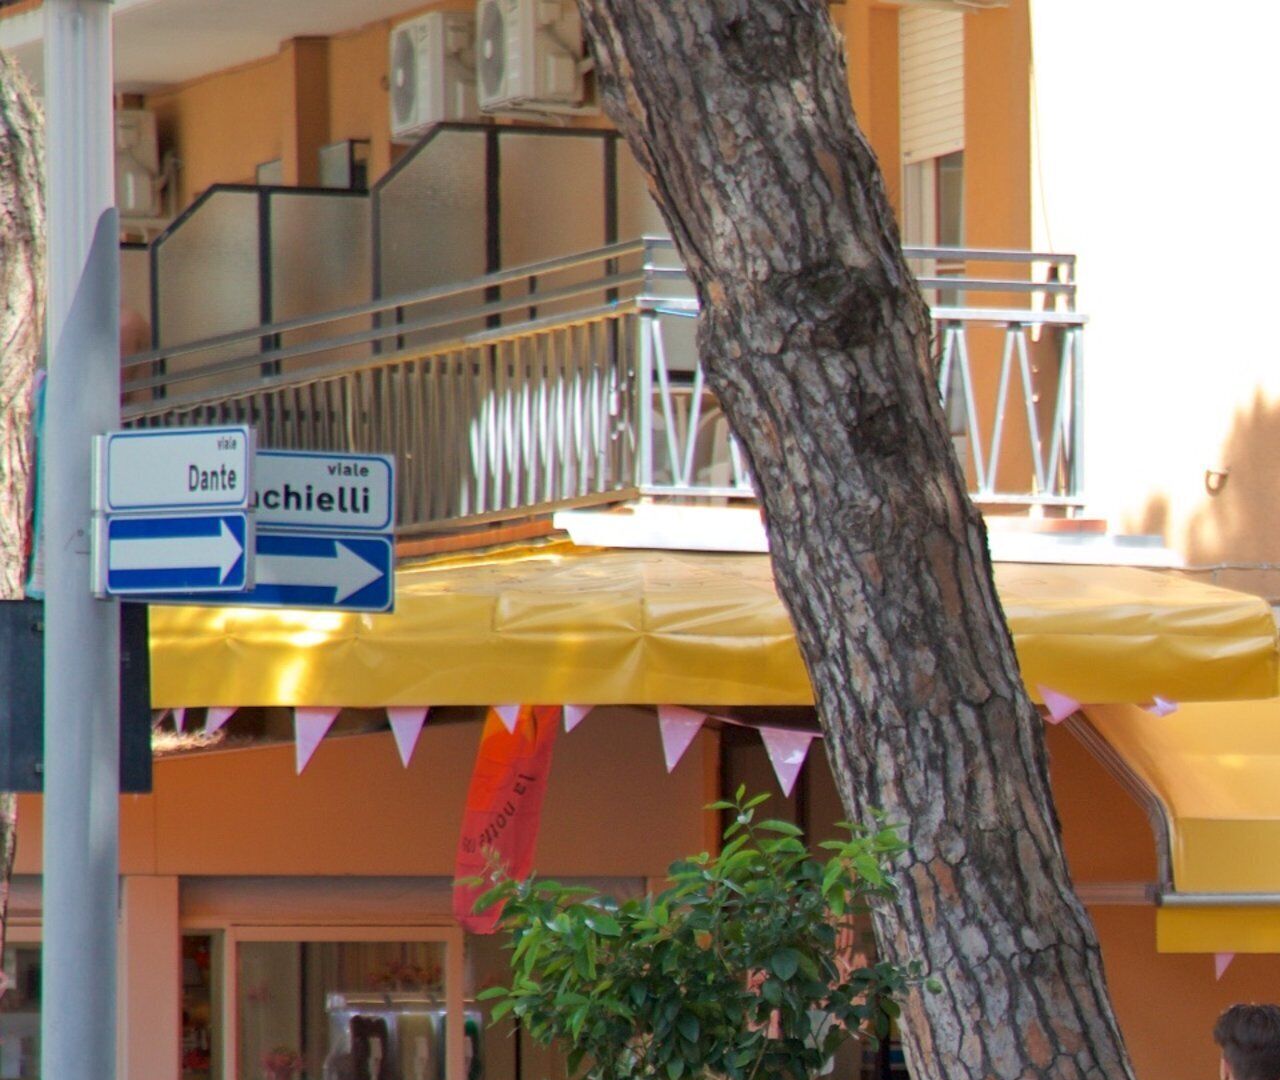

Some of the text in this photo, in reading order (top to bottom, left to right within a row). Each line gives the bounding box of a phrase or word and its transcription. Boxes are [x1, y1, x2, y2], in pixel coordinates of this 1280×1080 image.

[217, 436, 237, 451] viale
[328, 462, 370, 477] viale
[188, 464, 237, 492] Dante
